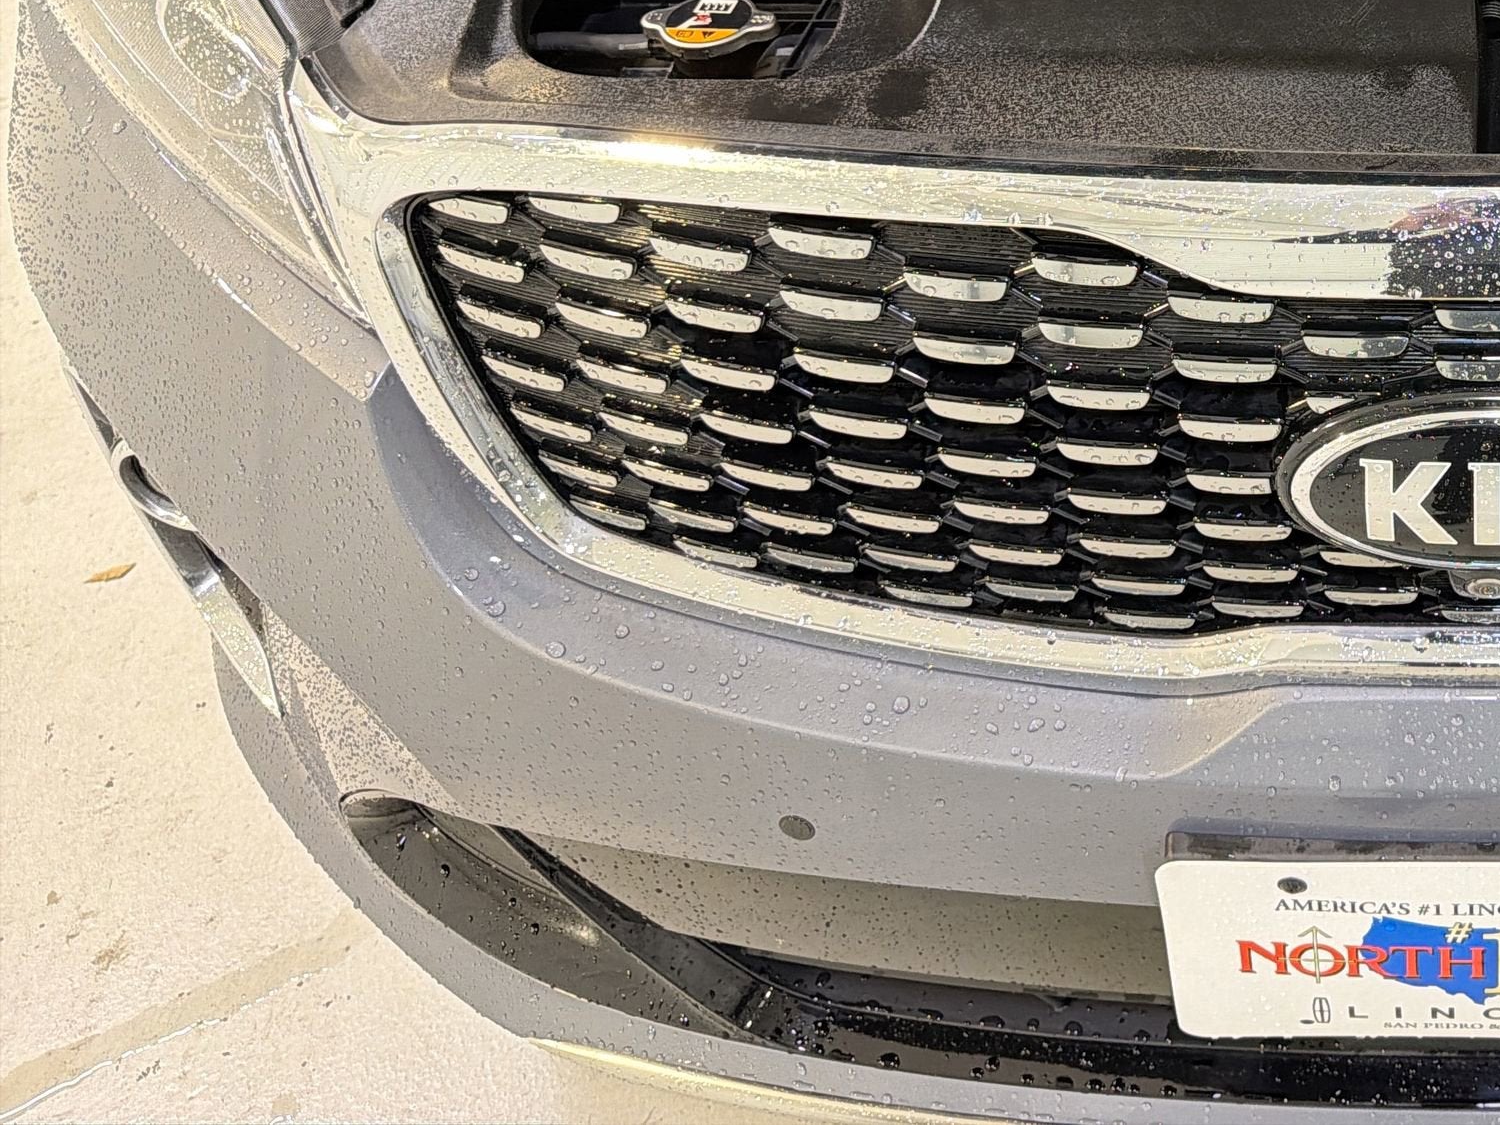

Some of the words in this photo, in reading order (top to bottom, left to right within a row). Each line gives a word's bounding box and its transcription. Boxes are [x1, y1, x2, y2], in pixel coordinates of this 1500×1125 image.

[1275, 898, 1410, 915] AMERICA'S
[1417, 903, 1444, 916] #1
[1235, 940, 1488, 980] NORTH
[1383, 1021, 1418, 1029] SAN
[1423, 1022, 1484, 1030] PEDRO
